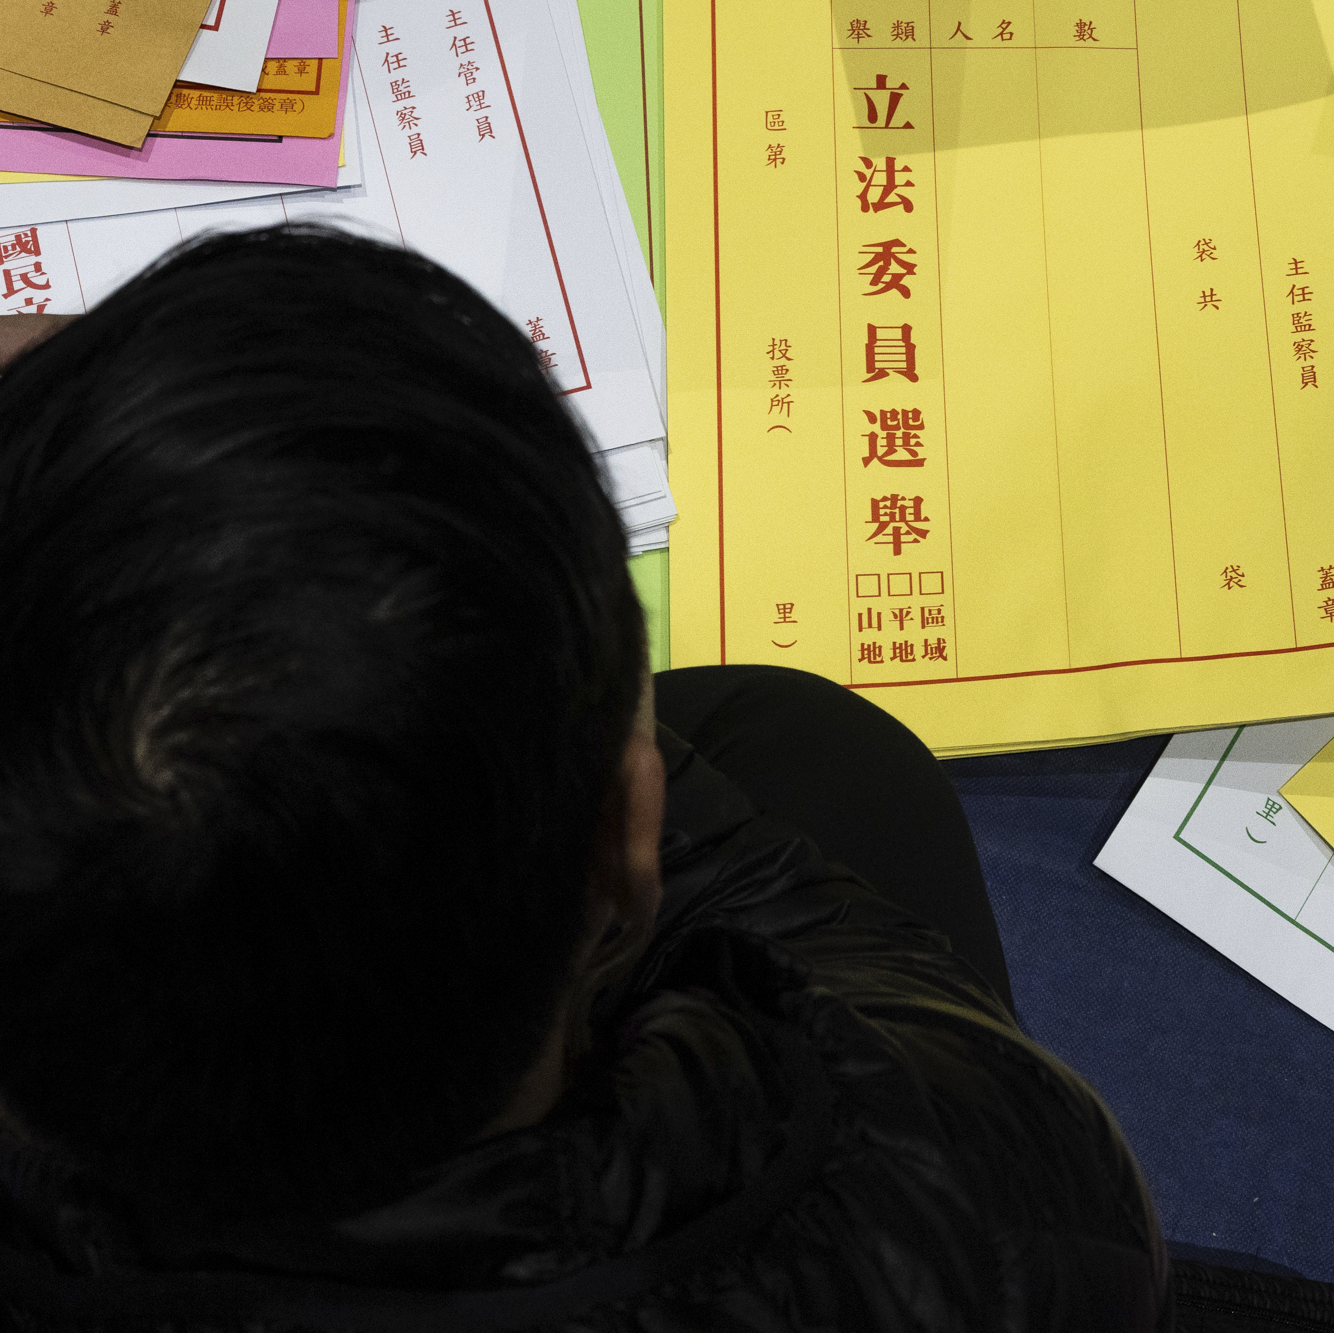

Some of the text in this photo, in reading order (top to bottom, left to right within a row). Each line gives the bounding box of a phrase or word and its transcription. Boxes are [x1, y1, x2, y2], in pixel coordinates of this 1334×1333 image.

[378, 24, 428, 159] 主任監察員
[446, 8, 496, 142] 主任管理員
[764, 109, 787, 169] 區第
[853, 73, 930, 557] 立法委員選舉
[1286, 257, 1319, 390] 主任監察員
[1221, 564, 1246, 591] 袋
[857, 607, 885, 665] 山地
[889, 606, 917, 663] 平地
[920, 606, 948, 662] 區域
